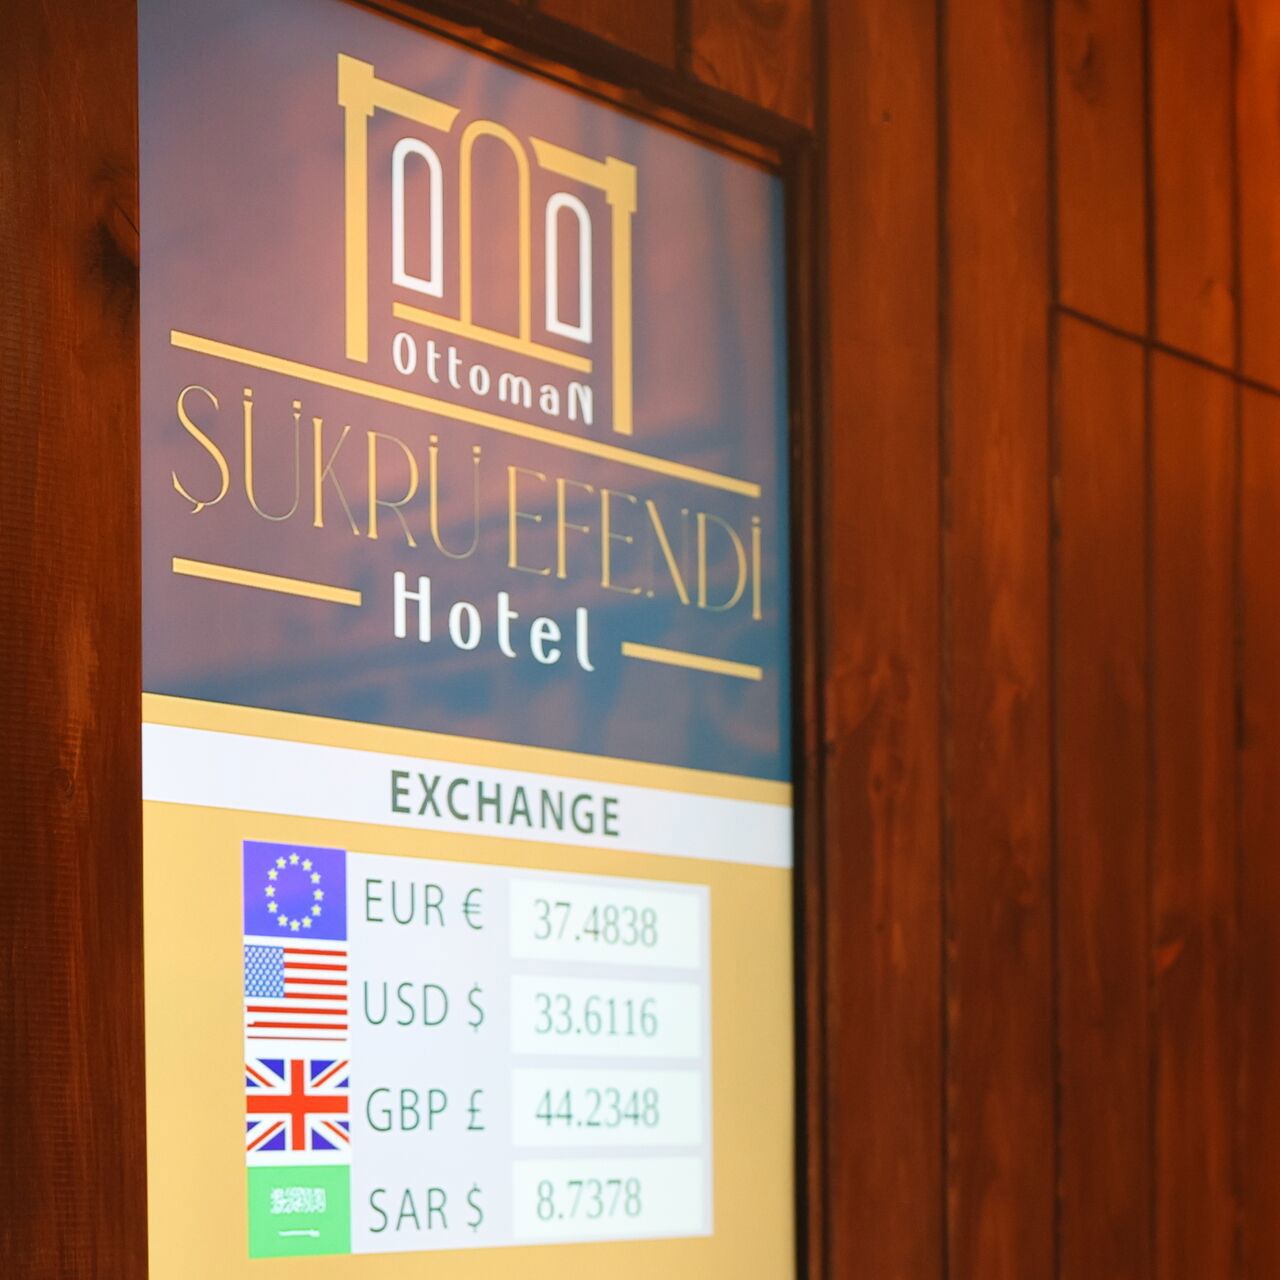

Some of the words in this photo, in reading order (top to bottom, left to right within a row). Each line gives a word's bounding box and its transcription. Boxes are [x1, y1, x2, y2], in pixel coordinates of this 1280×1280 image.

[171, 384, 481, 560] ŞÜKRÜ
[506, 465, 763, 621] EFENDİ
[392, 571, 595, 672] Hotel
[390, 769, 621, 837] EXCHANGE
[364, 877, 446, 928] EUR
[461, 887, 486, 930] €
[533, 898, 659, 948] 37.4838
[362, 980, 449, 1027] USD
[468, 982, 485, 1031] $
[534, 992, 659, 1038] 33.6116
[365, 1087, 449, 1133] GBP
[466, 1089, 486, 1132] £
[535, 1087, 660, 1128] 44.2348
[368, 1186, 449, 1233] SAR
[466, 1183, 484, 1233] $
[536, 1177, 643, 1221] 8.7378
